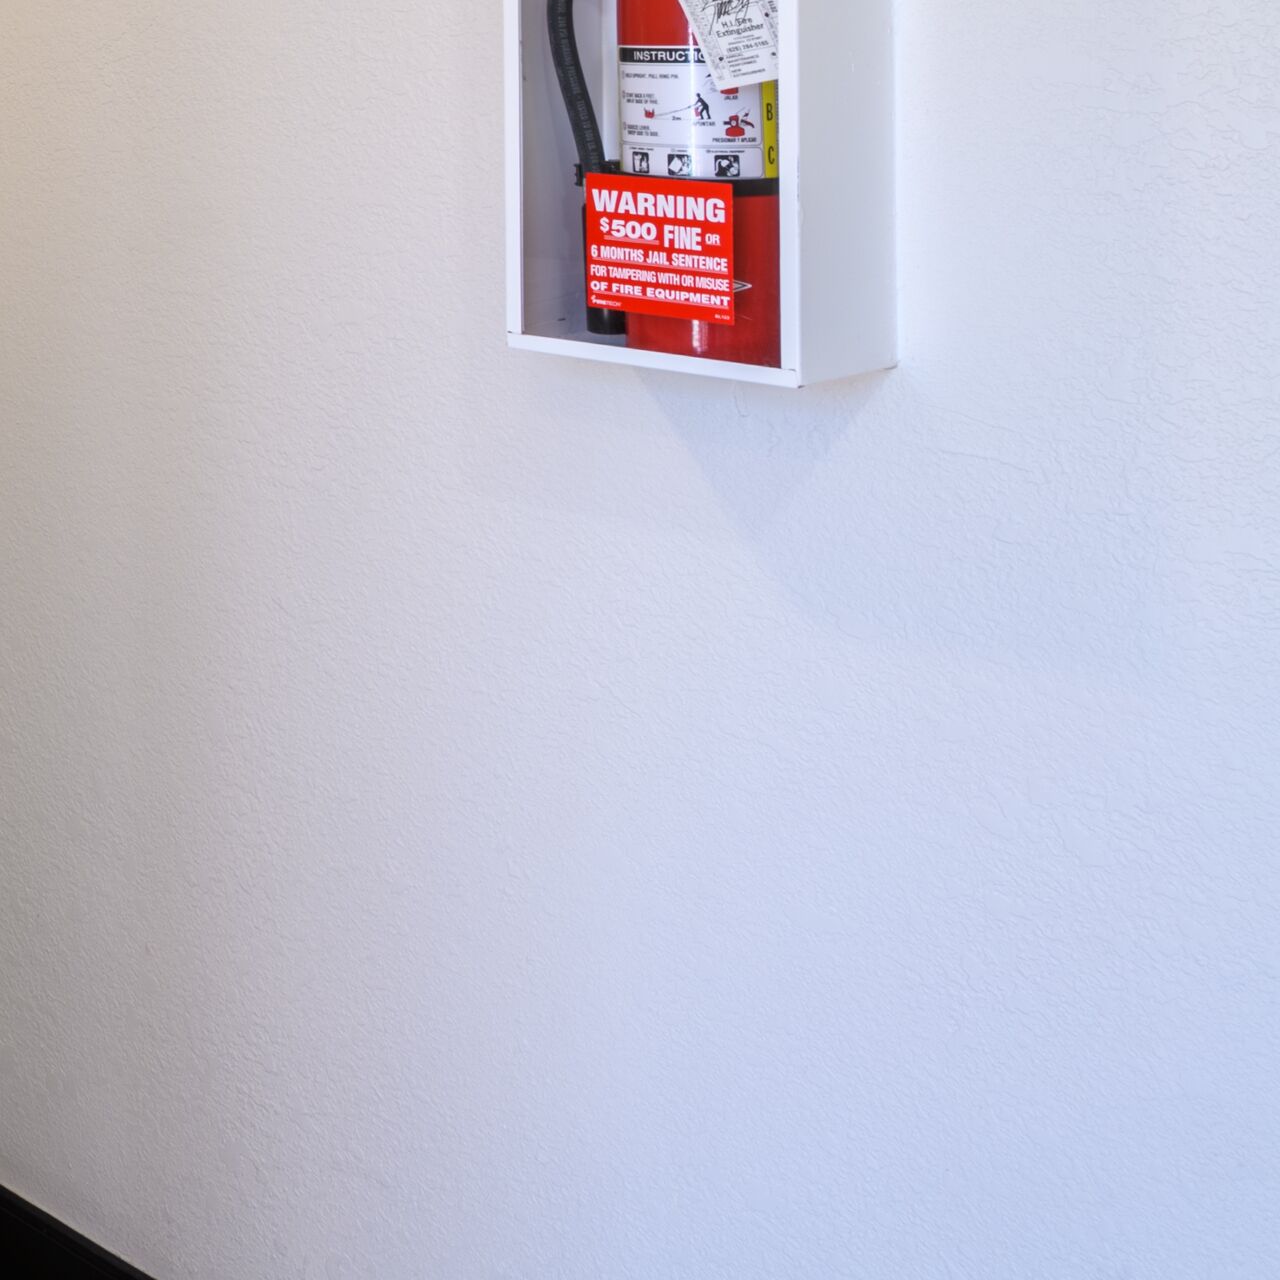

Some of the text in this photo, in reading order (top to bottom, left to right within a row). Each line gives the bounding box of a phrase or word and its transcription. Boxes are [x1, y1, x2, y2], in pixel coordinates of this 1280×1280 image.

[716, 23, 764, 38] Extinguisher
[634, 50, 705, 62] INSTRUCTIO
[766, 103, 773, 120] B
[768, 145, 776, 164] C
[592, 188, 725, 223] WARNING
[600, 217, 720, 251] $500 FINE OR
[591, 244, 728, 272] 6 MONTHS JAIL SENTENCE
[590, 264, 730, 292] FOR TAMPERING WITH OR MISUSE
[590, 281, 730, 306] OF FIRE EQUIPMENT
